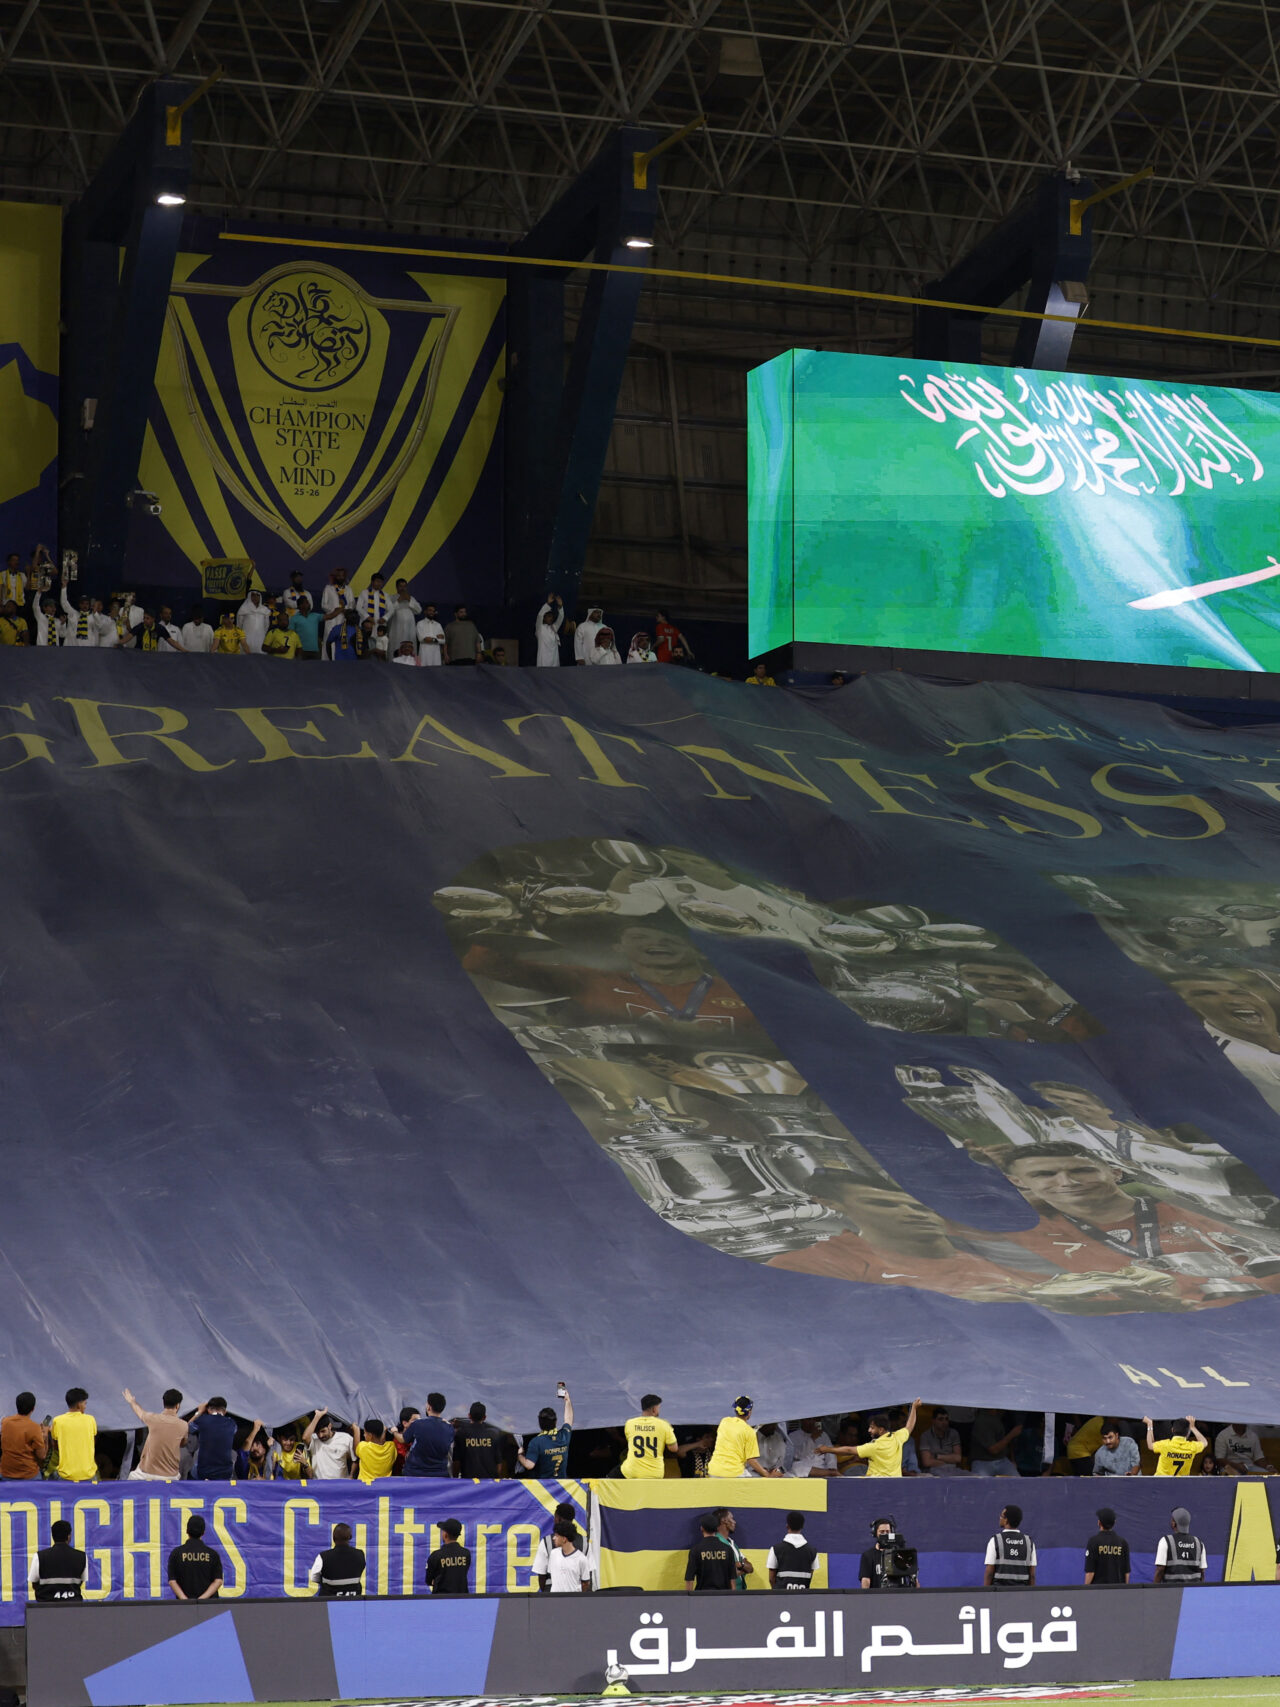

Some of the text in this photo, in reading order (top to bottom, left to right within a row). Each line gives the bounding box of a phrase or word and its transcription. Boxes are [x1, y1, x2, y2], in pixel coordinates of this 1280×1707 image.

[249, 406, 366, 431] CHAMPION
[275, 428, 340, 449] STATE
[293, 448, 323, 467] OF
[279, 466, 336, 487] MIND
[1115, 1362, 1250, 1389] ALL
[465, 1437, 492, 1448] POLICE
[632, 1434, 658, 1459] 94
[1166, 1451, 1193, 1460] RONALDO
[551, 1454, 564, 1478] 7
[1172, 1460, 1186, 1476] 7
[282, 1495, 542, 1599] Culture
[1005, 1537, 1024, 1546] Guard
[1177, 1540, 1195, 1549] Guard
[181, 1551, 210, 1563] POLICE
[700, 1550, 727, 1562] POLICE
[1009, 1548, 1019, 1557] 86
[1098, 1545, 1122, 1556] POLICE
[1180, 1550, 1190, 1560] 41
[440, 1555, 468, 1569] POLICE
[606, 1605, 1078, 1677] قوائم الفرق
